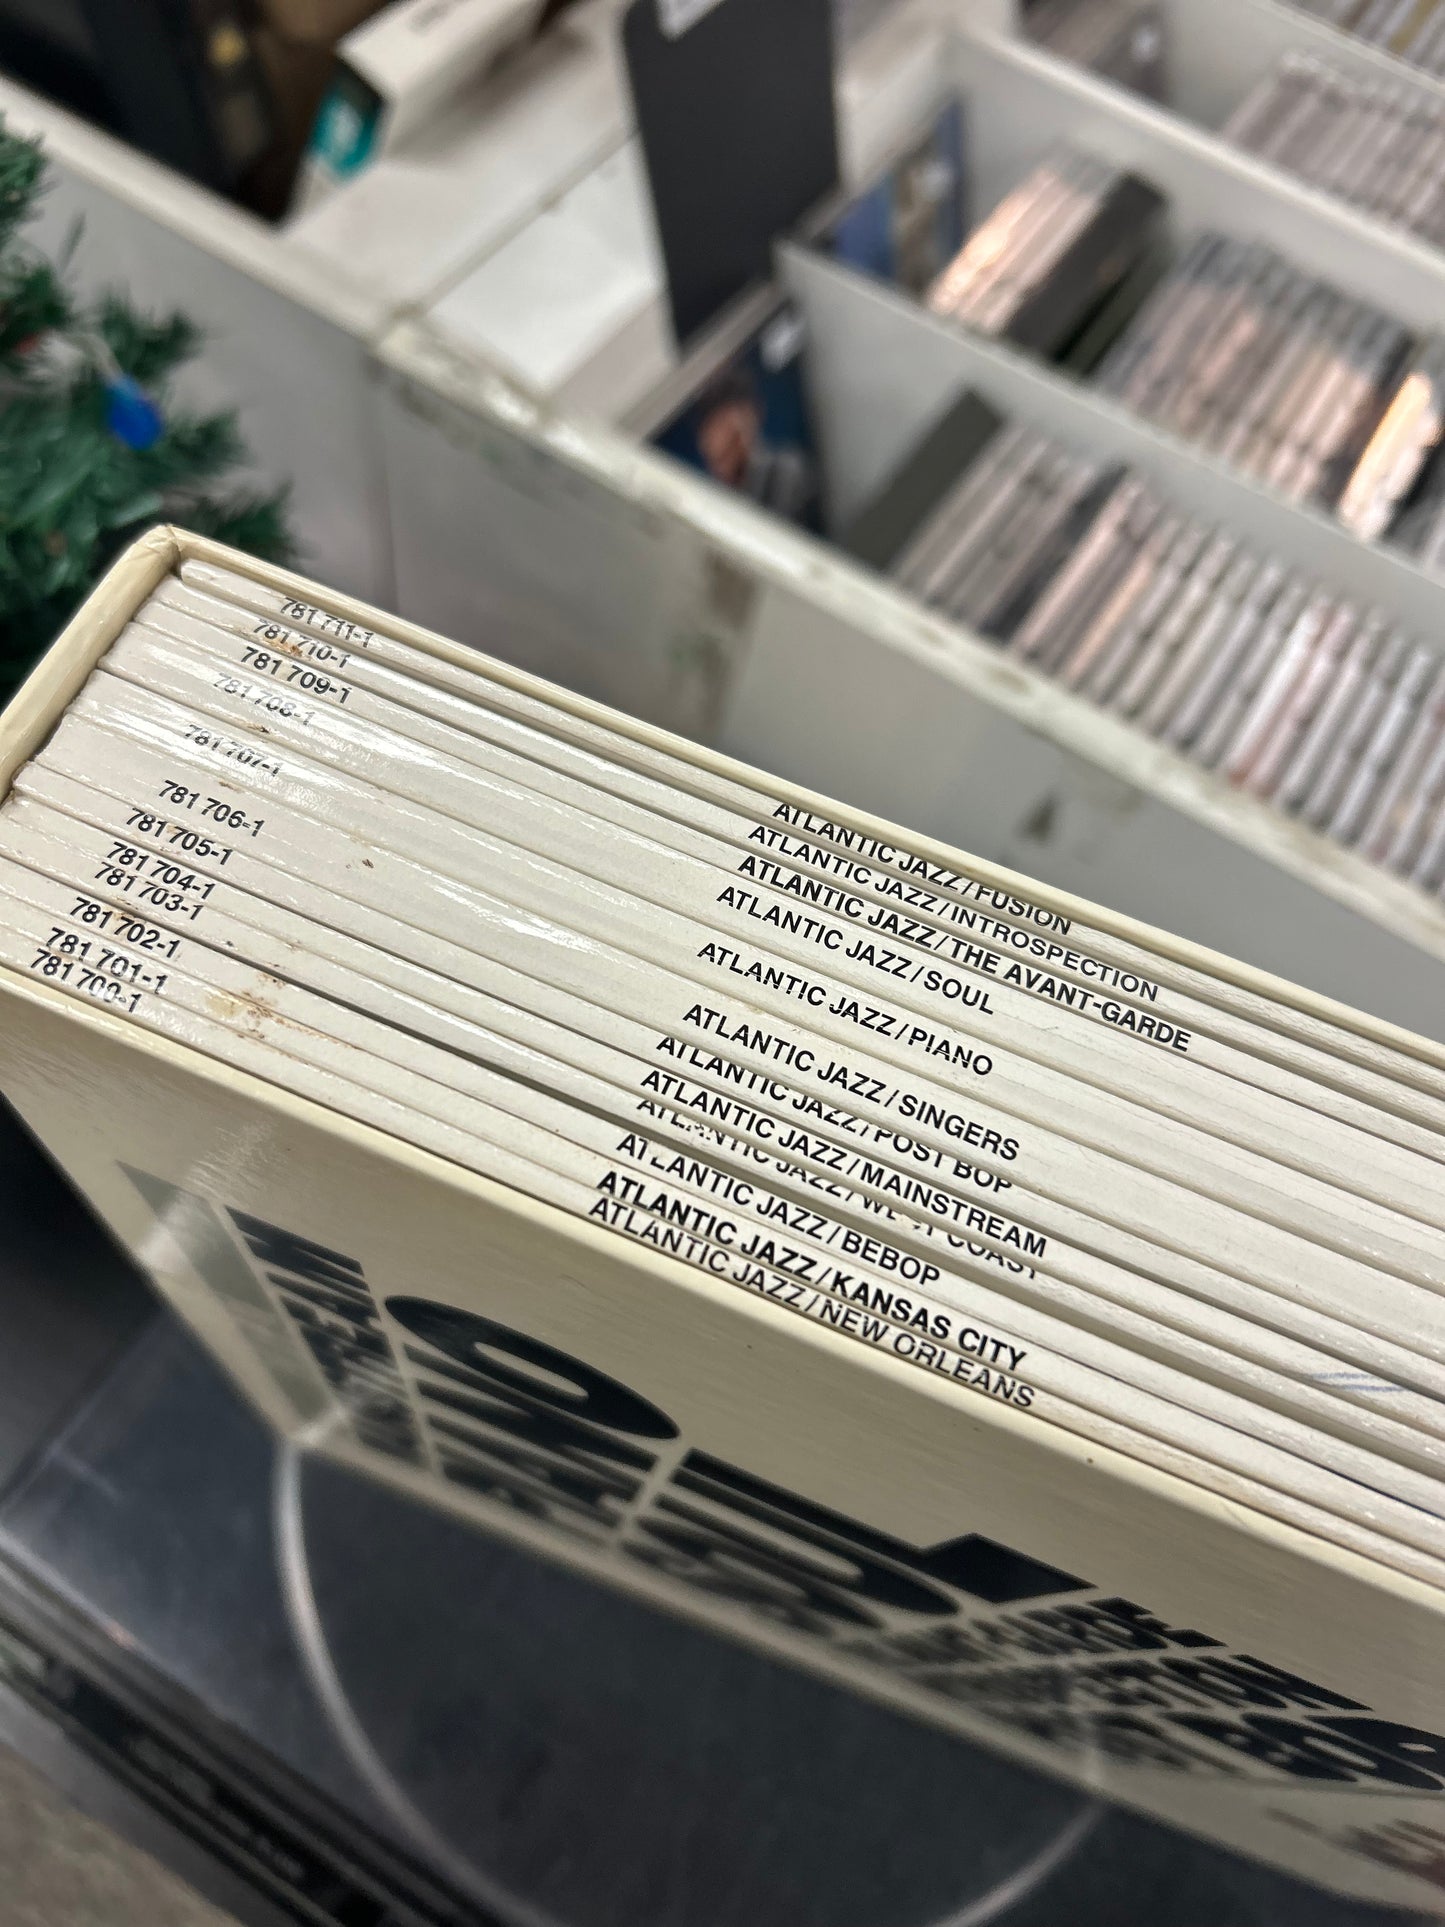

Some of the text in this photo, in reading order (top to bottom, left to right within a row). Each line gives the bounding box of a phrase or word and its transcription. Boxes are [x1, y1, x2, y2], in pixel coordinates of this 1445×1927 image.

[253, 618, 351, 668] 781 710-1
[280, 597, 374, 648] 781 711-1
[213, 672, 316, 726] 781 708-1
[241, 646, 352, 704] 781 709-1
[184, 724, 283, 777] 781 707-1
[126, 808, 233, 866] 781 705-1
[158, 780, 264, 837] 781 706-1
[772, 803, 897, 863] ATLANTIC
[106, 842, 216, 900] 781 704-1
[748, 826, 872, 884] ATLANTIC
[94, 862, 204, 921] 781 703-1
[716, 886, 844, 950] ATLANTIC
[70, 897, 181, 958] 781 702-1
[738, 856, 864, 918] ATLANTIC
[1004, 964, 1192, 1052] AVANT-GARDE
[30, 948, 142, 1013] 781 700-1
[46, 927, 168, 996] 781 701-1
[697, 942, 826, 1006] ATLANTIC
[682, 1004, 815, 1072] ATLANTIC
[640, 1070, 775, 1138] ATLANTIC
[656, 1036, 789, 1100] ATLANTIC
[952, 1160, 1012, 1193] BOP
[616, 1134, 754, 1205] ATLANTIC
[596, 1170, 738, 1244] ATLANTIC
[958, 1328, 1027, 1371] CITY
[588, 1197, 730, 1272] ATLANTIC
[893, 1333, 1036, 1408] ORLEANS
